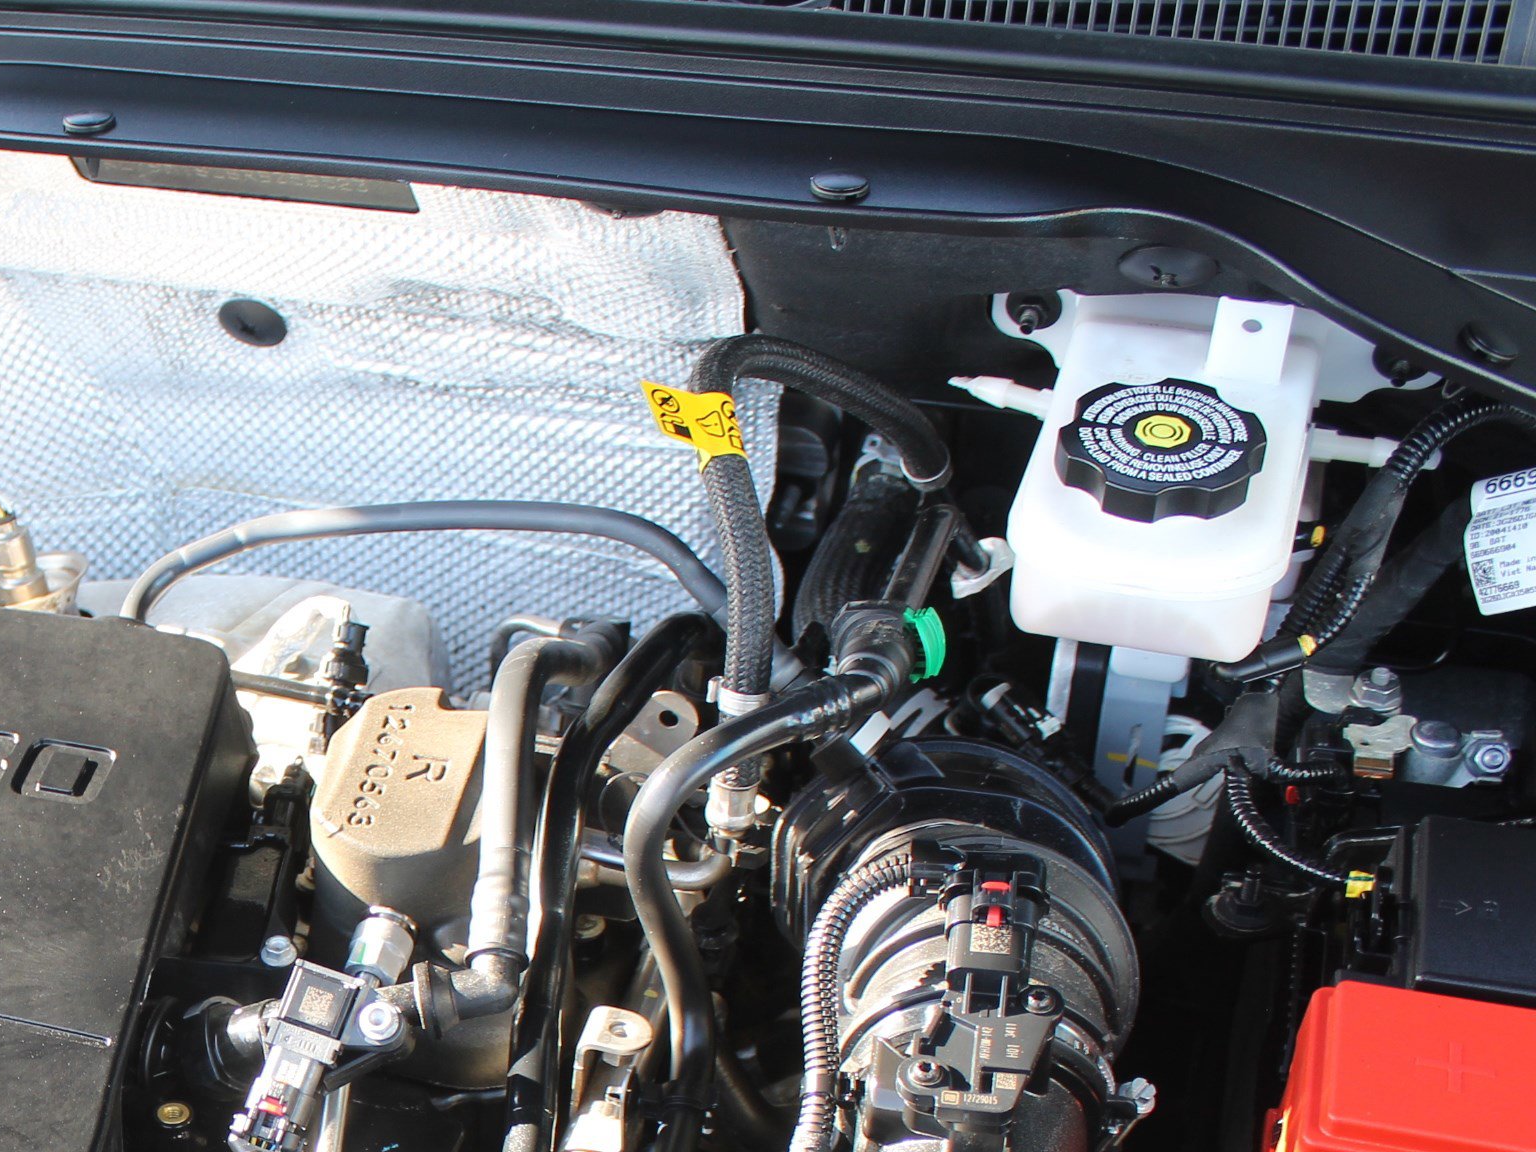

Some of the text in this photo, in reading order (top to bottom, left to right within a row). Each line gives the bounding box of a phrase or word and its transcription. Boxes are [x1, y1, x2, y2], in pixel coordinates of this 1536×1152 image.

[1162, 386, 1176, 394] LE
[1099, 440, 1132, 464] BEFORE
[1143, 453, 1180, 463] CLEAN
[1179, 442, 1212, 461] FILLER
[1106, 460, 1139, 477] FROM
[1137, 471, 1146, 479] A
[1148, 471, 1193, 482] SEALED
[1191, 449, 1244, 479] CONTAINER
[347, 704, 414, 826] 12670563
[405, 754, 451, 782] R
